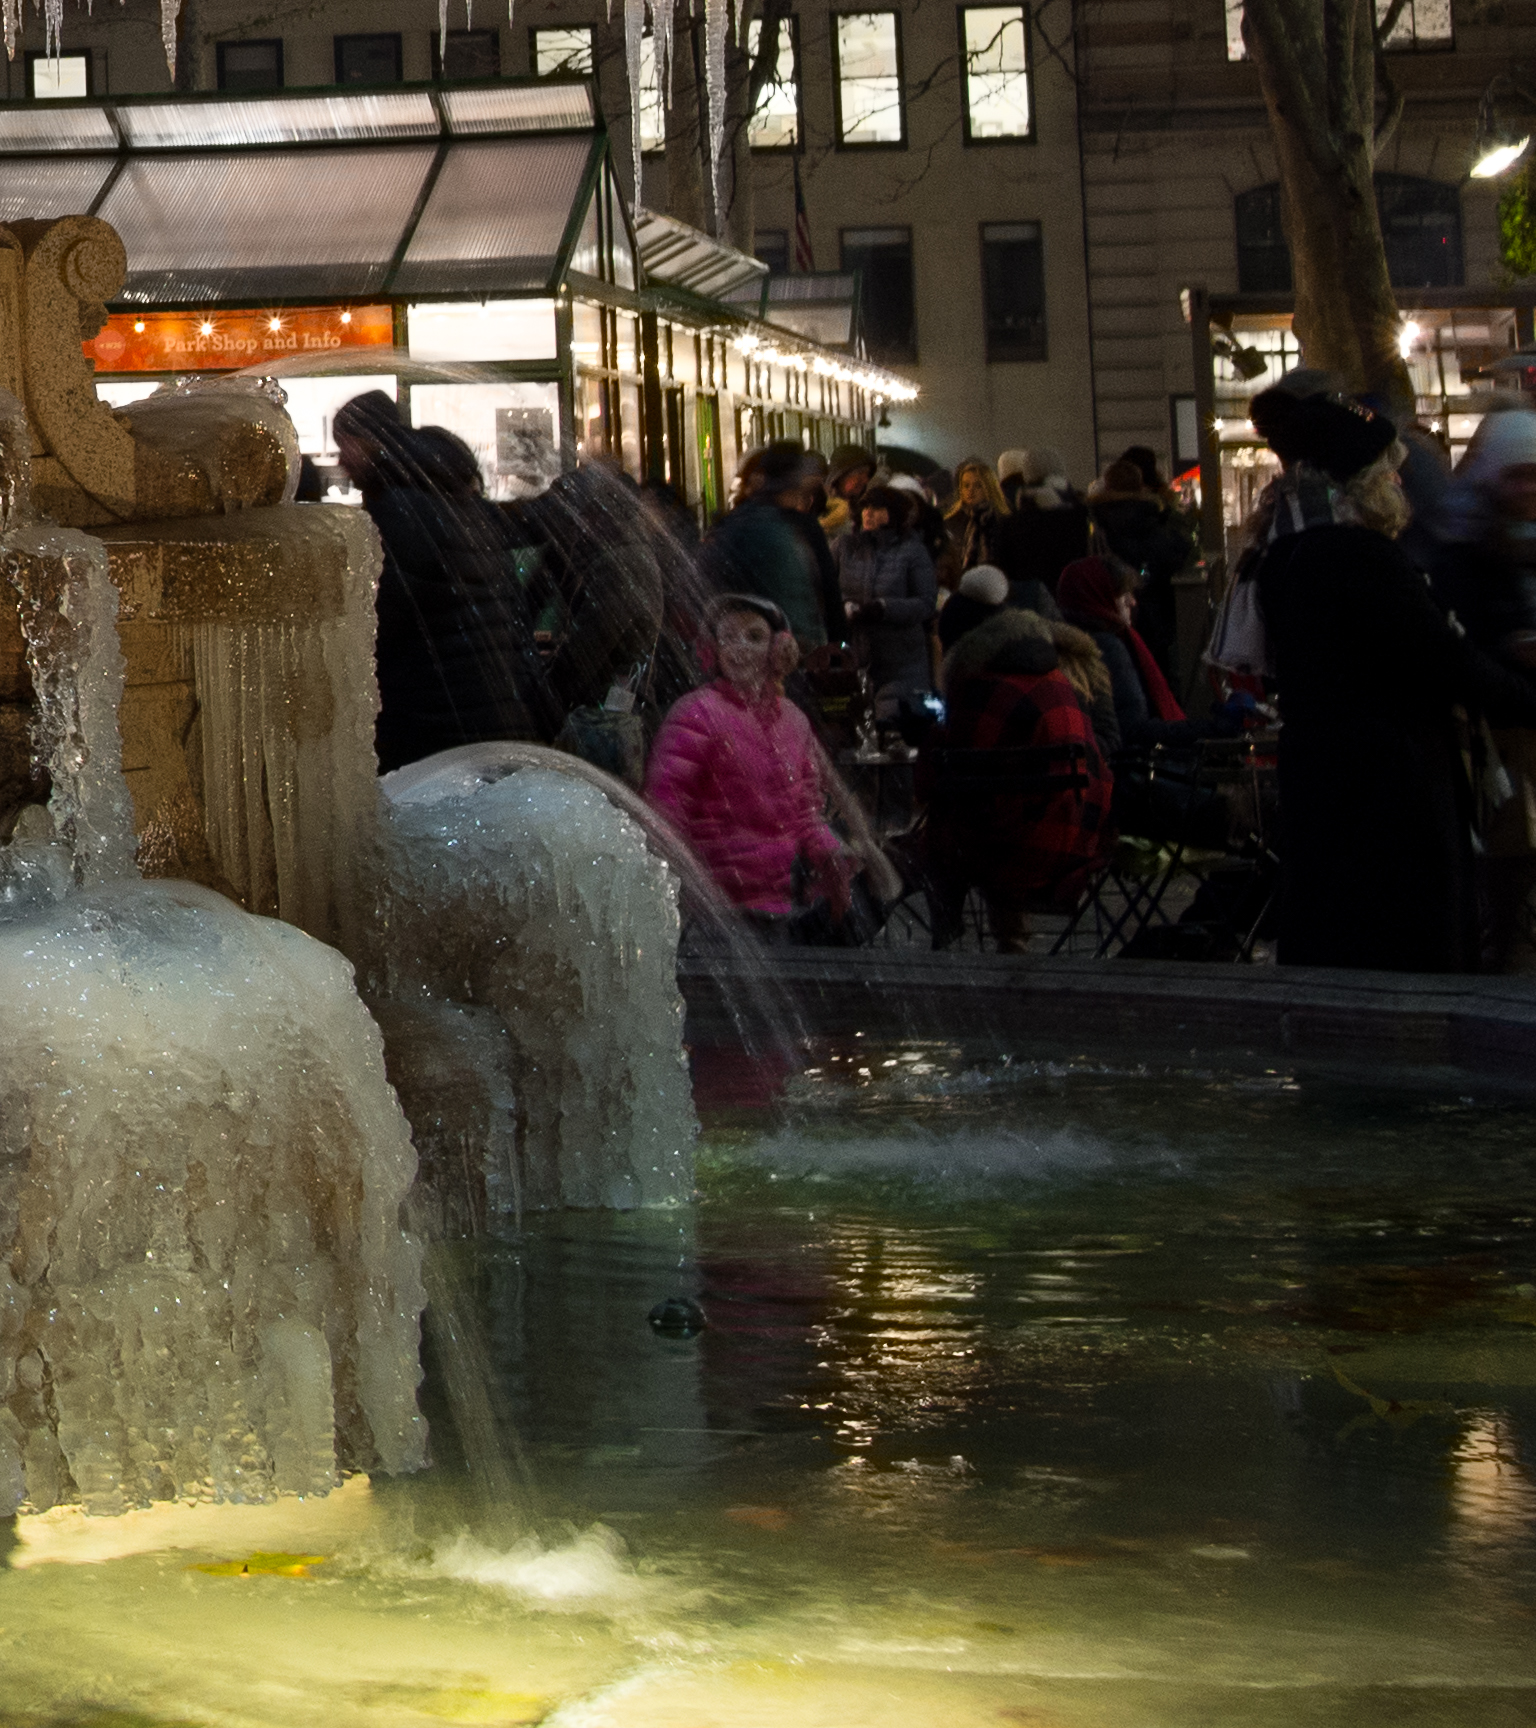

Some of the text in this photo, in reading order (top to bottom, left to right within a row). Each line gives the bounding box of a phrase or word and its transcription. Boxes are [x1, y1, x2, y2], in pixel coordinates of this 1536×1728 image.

[163, 330, 342, 355] Park Shop and Info
